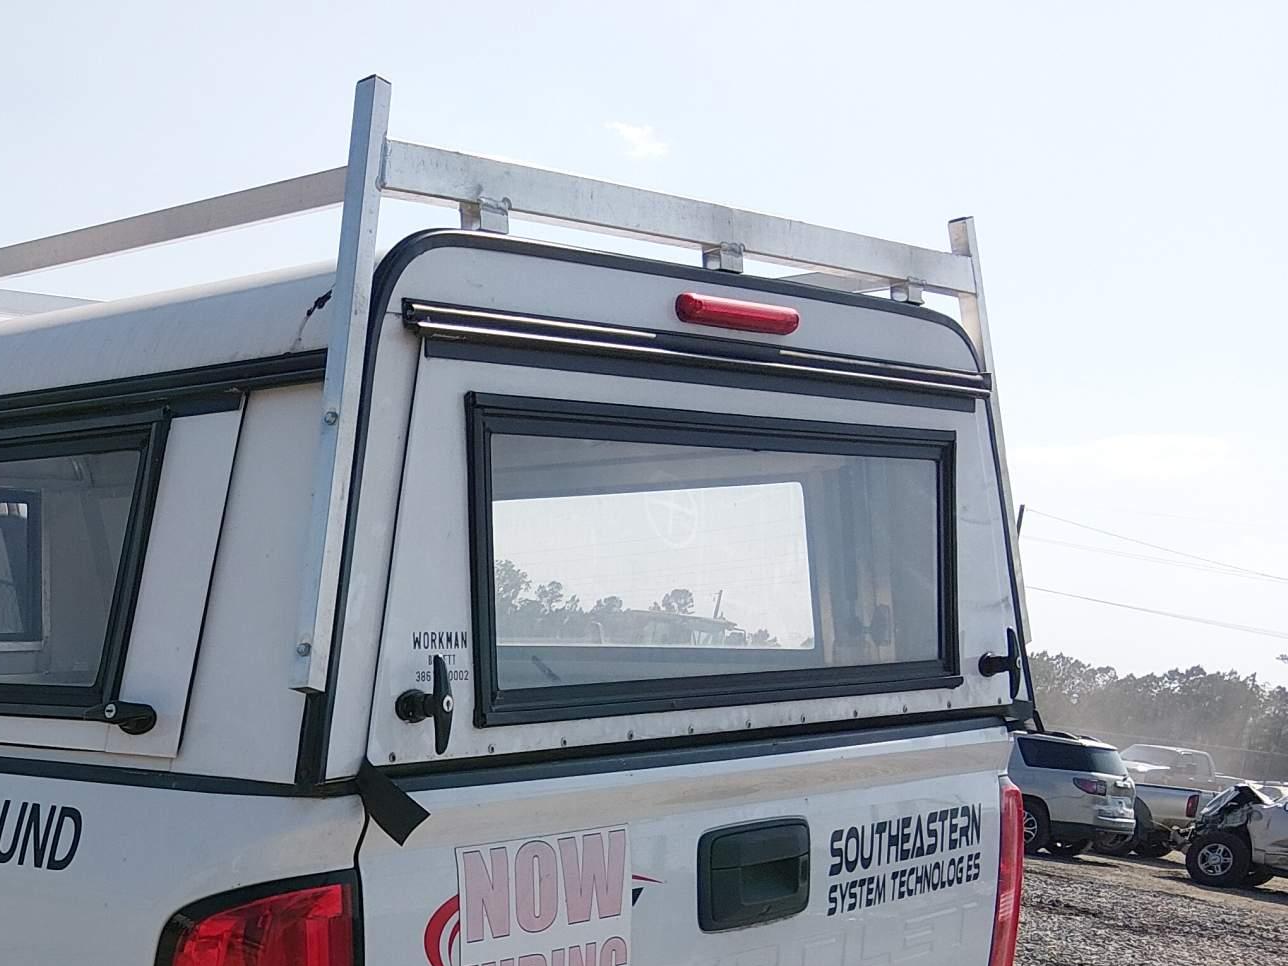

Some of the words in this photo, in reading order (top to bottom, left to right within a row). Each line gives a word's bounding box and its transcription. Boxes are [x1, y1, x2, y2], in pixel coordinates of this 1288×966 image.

[412, 631, 468, 650] WORKMAN
[828, 803, 982, 877] SOUTHEASTERN
[462, 828, 627, 944] NOW
[826, 872, 887, 917] SYSTEM
[890, 852, 981, 901] TECHNOLOGES
